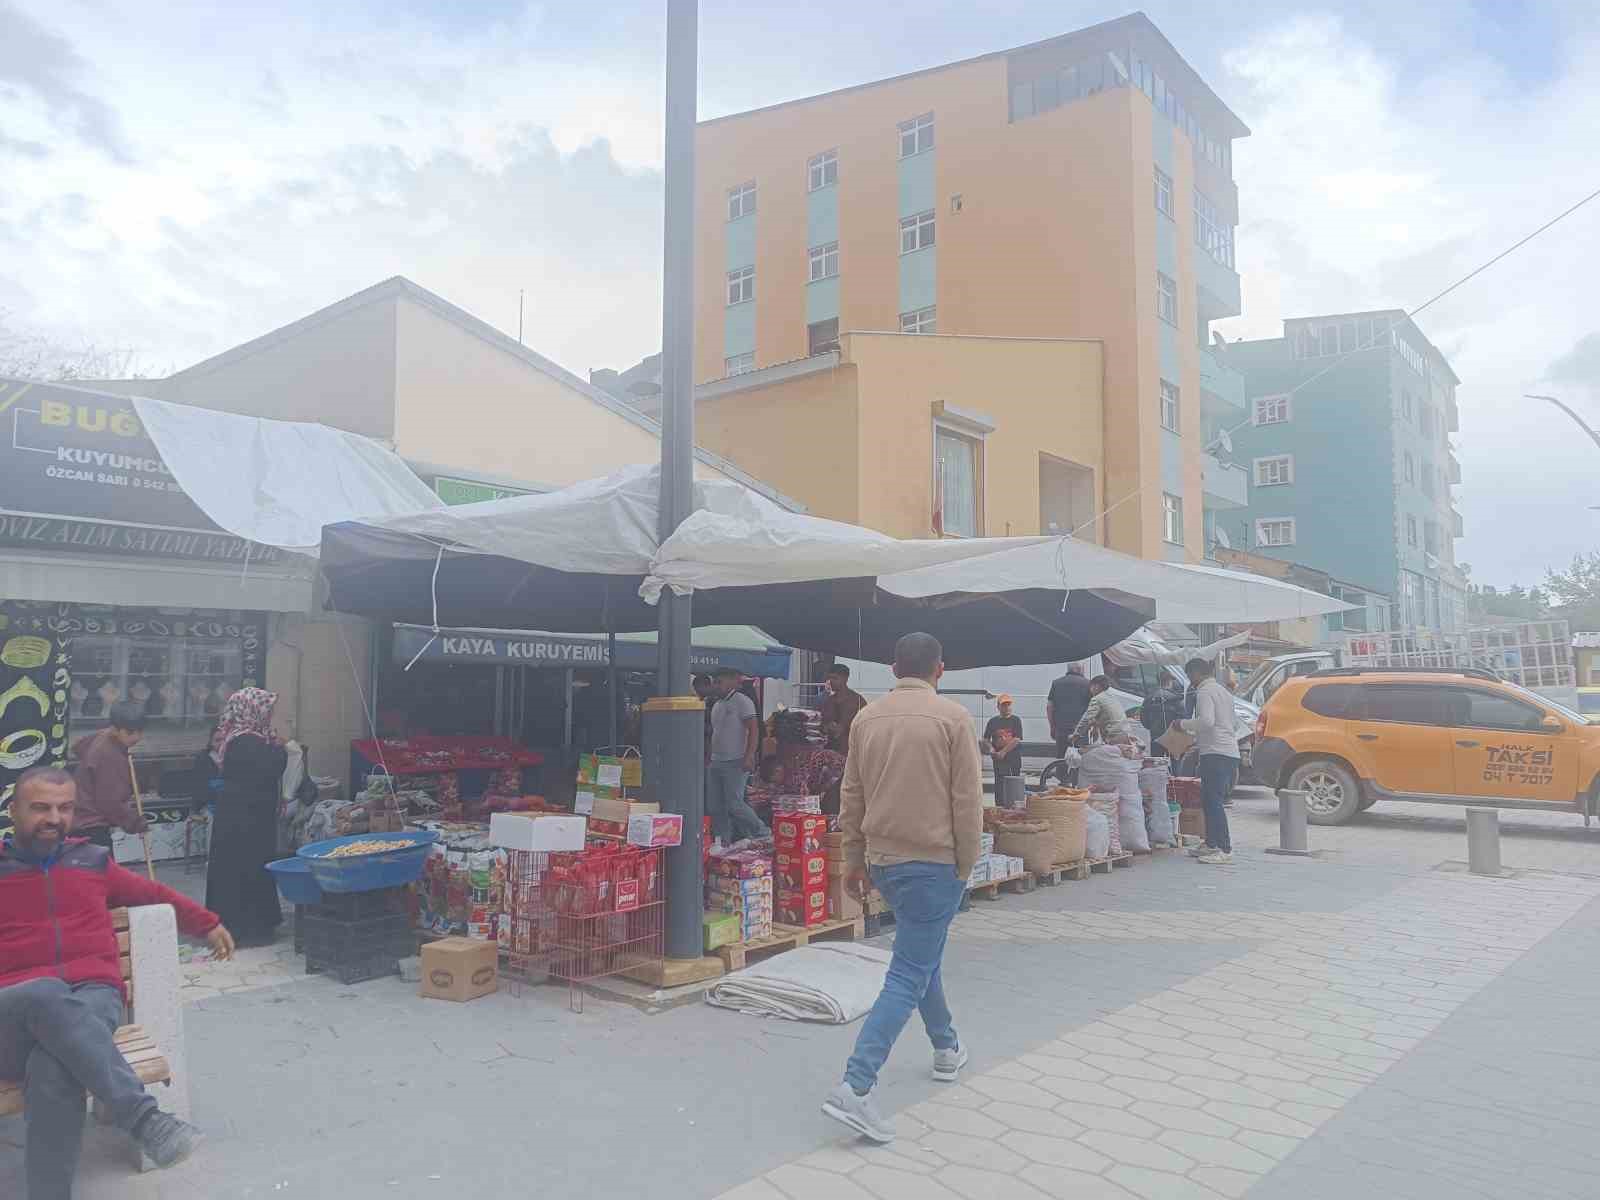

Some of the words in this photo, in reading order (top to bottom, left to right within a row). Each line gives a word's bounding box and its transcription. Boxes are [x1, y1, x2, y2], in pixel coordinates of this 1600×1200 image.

[46, 465, 94, 482] ÖZCAN
[97, 474, 128, 486] SARI
[442, 637, 497, 656] KAYA
